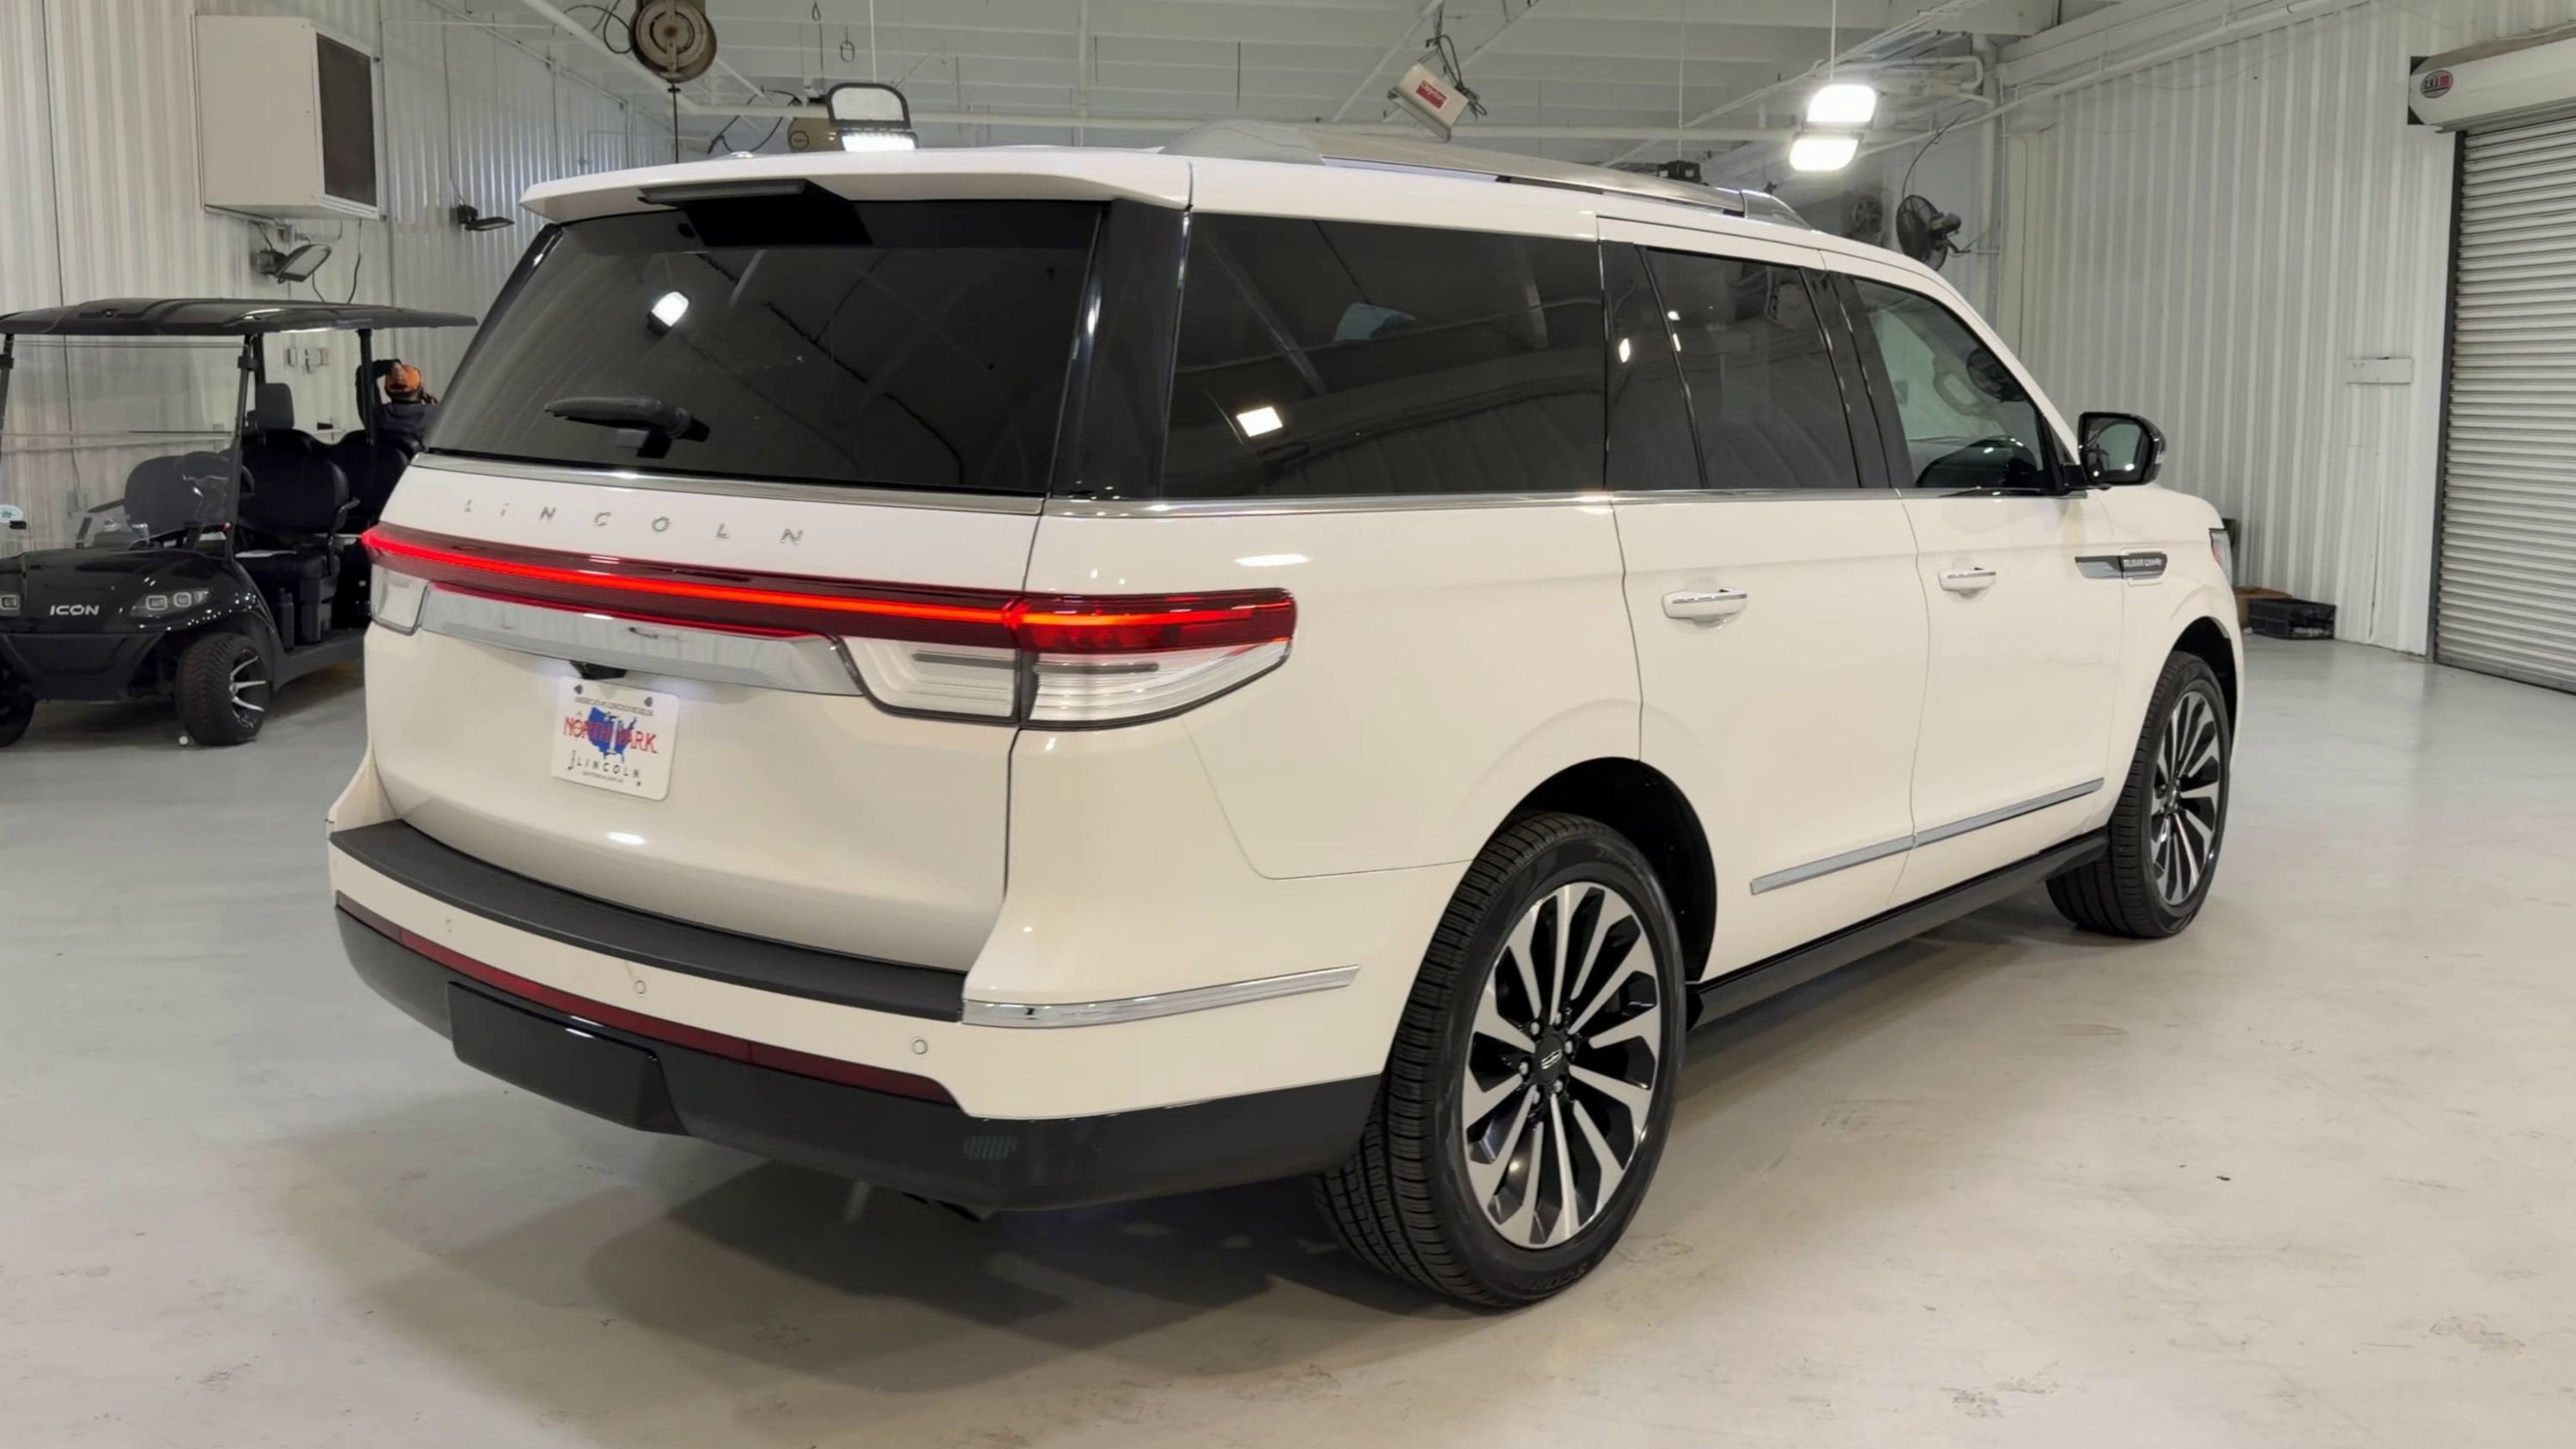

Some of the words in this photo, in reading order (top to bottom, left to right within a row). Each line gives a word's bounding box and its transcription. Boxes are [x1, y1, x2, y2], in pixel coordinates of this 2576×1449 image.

[463, 499, 804, 546] LINCOLN
[50, 604, 100, 615] ICON
[576, 756, 641, 779] LINCOLN
